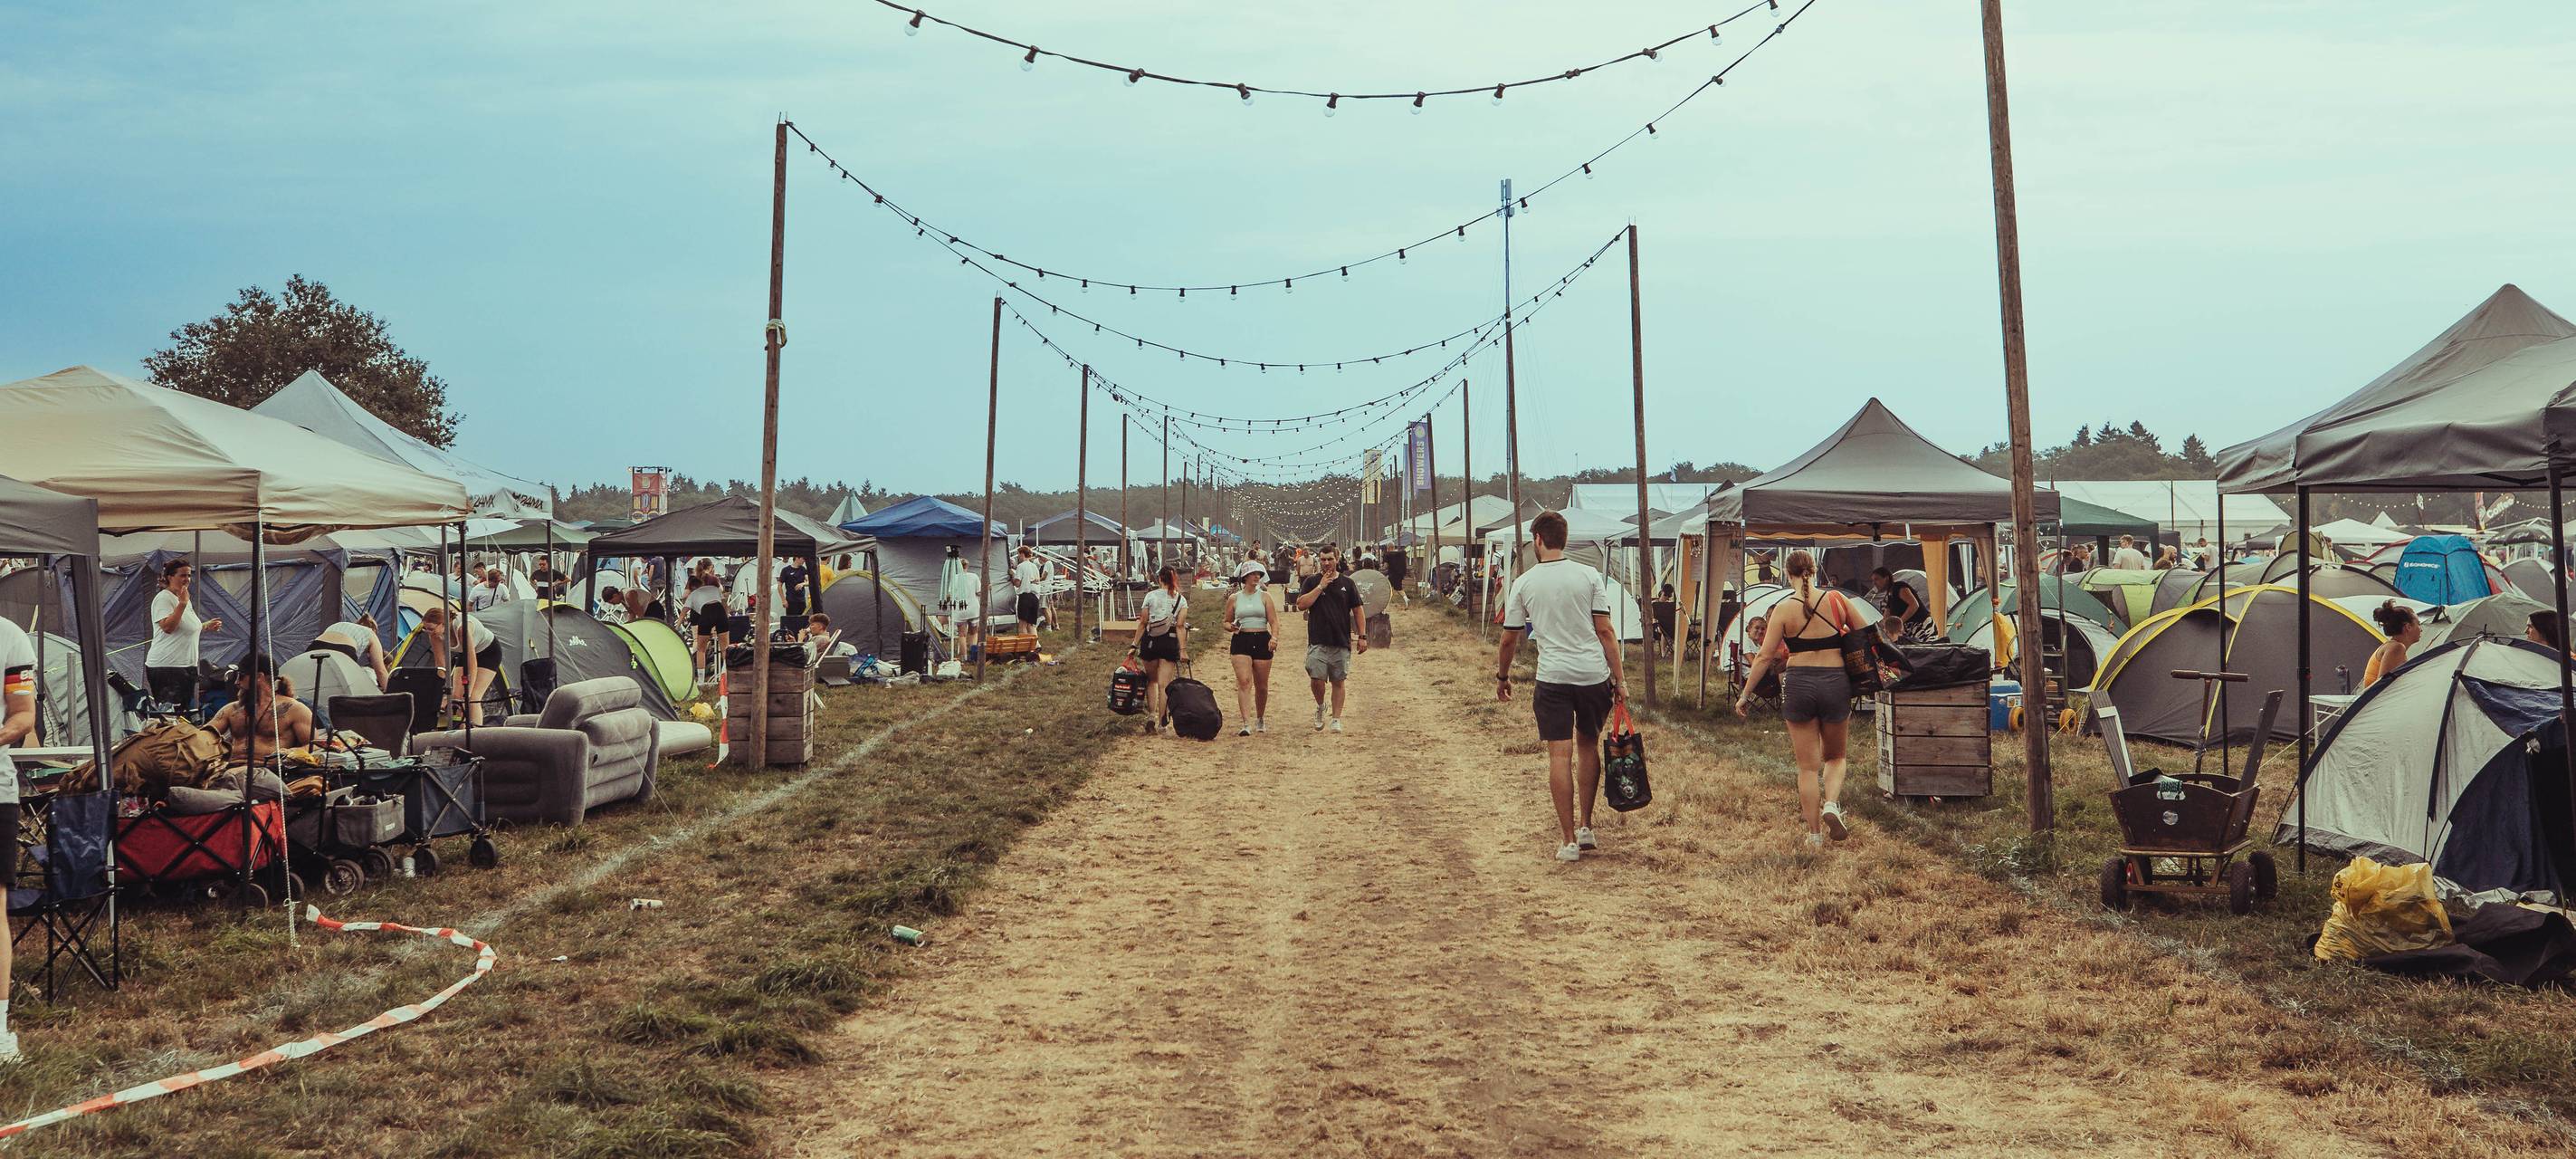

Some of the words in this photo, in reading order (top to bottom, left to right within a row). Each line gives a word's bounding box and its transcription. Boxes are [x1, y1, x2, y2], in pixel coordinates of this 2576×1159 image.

[1416, 441, 1425, 485] SHOWERS
[473, 495, 496, 507] 24MX
[2486, 498, 2514, 518] Coffee
